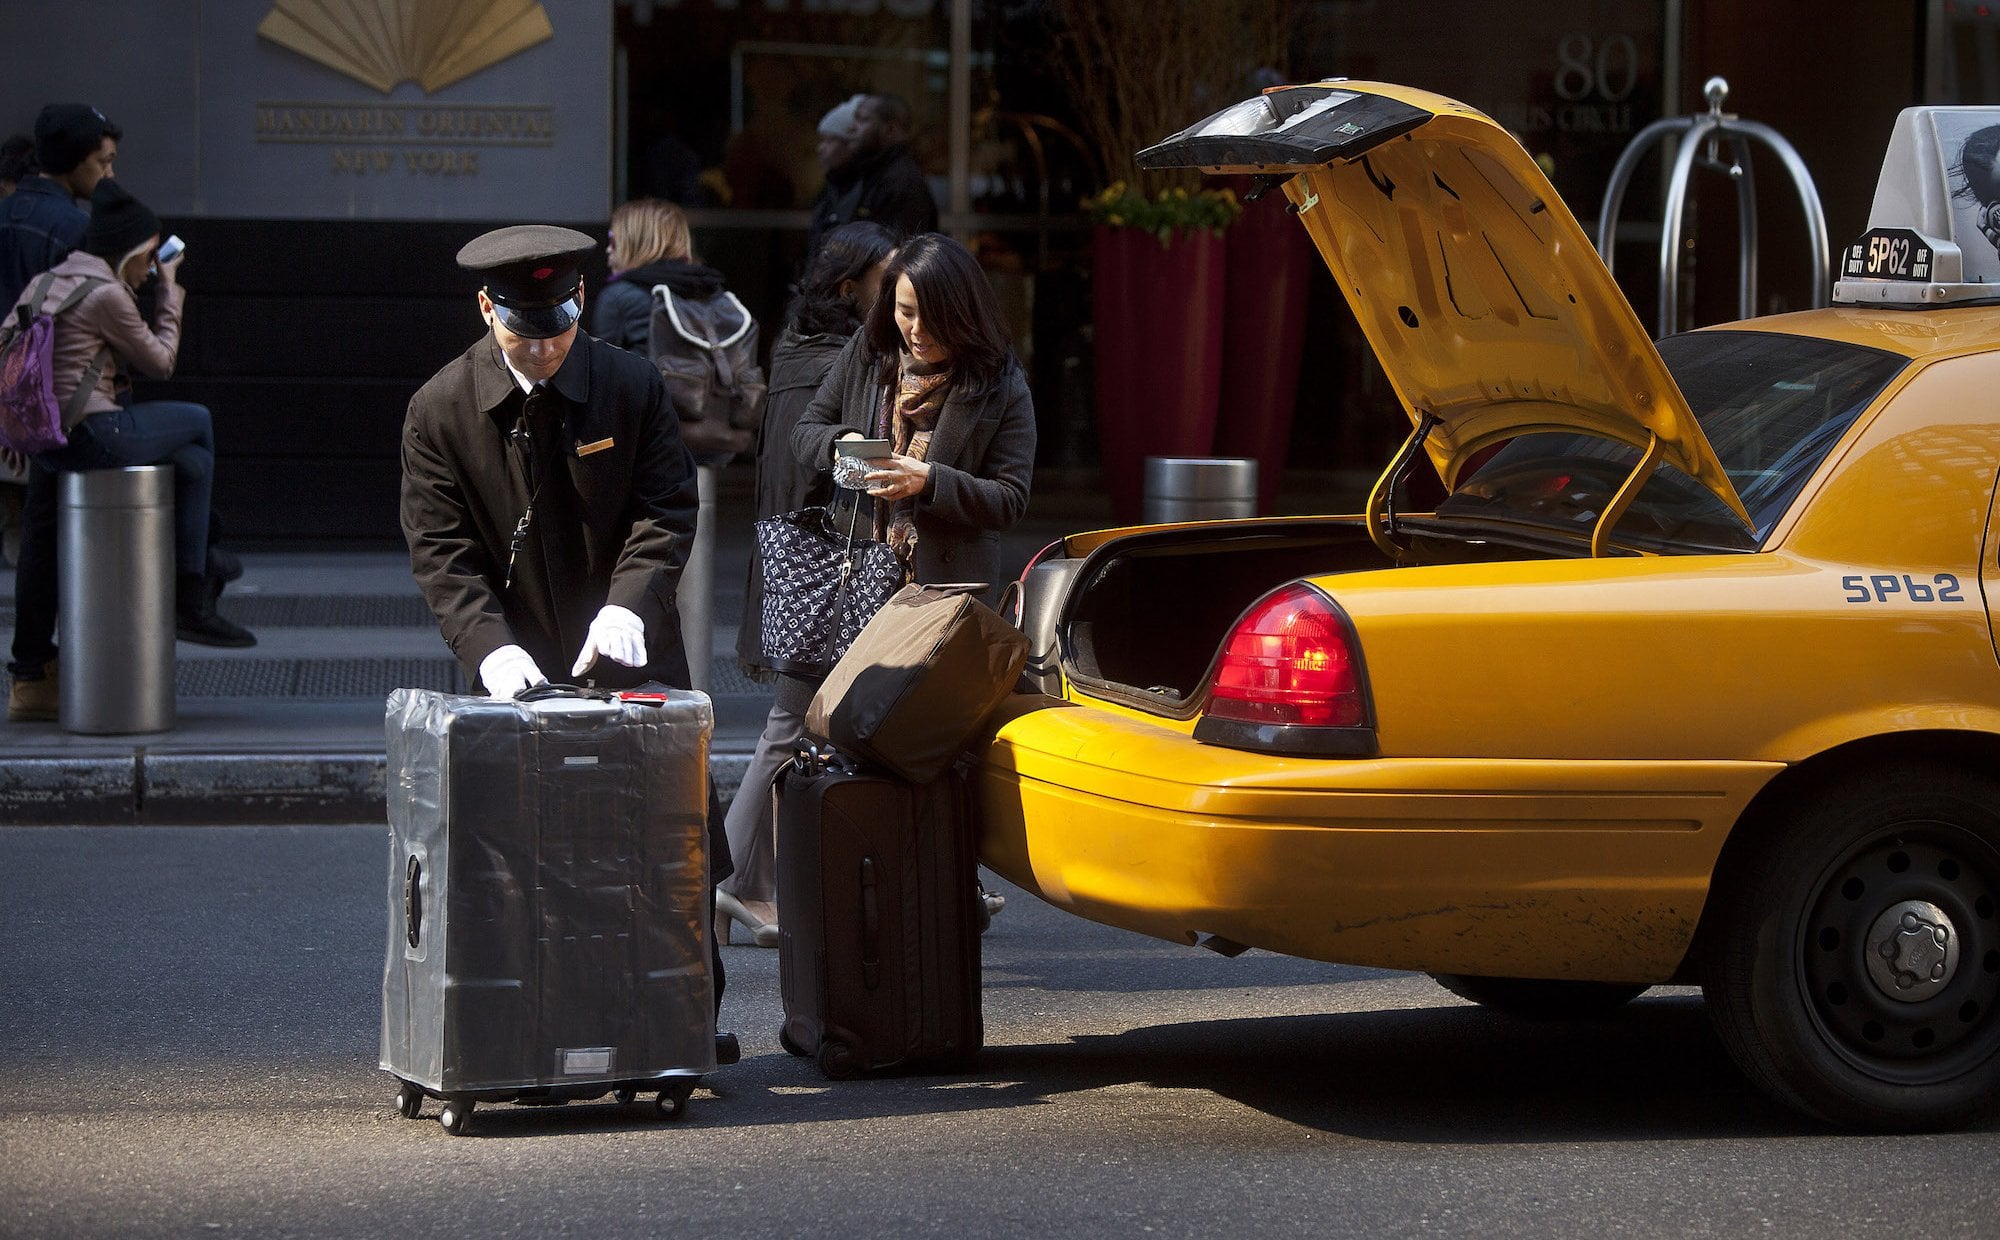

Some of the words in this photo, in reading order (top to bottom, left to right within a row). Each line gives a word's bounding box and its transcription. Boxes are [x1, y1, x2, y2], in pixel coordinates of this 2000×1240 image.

[1554, 33, 1638, 102] 80
[256, 109, 404, 134] MANDARIN
[416, 110, 553, 138] ORIENTAL
[331, 149, 395, 175] NEW
[403, 151, 479, 177] YORK
[1852, 244, 1864, 259] OFF
[1867, 236, 1910, 275] 5P62
[1916, 248, 1928, 263] OFF
[1848, 259, 1864, 274] DUTY
[1912, 263, 1929, 278] DUTY
[1842, 573, 1965, 603] 5P62
